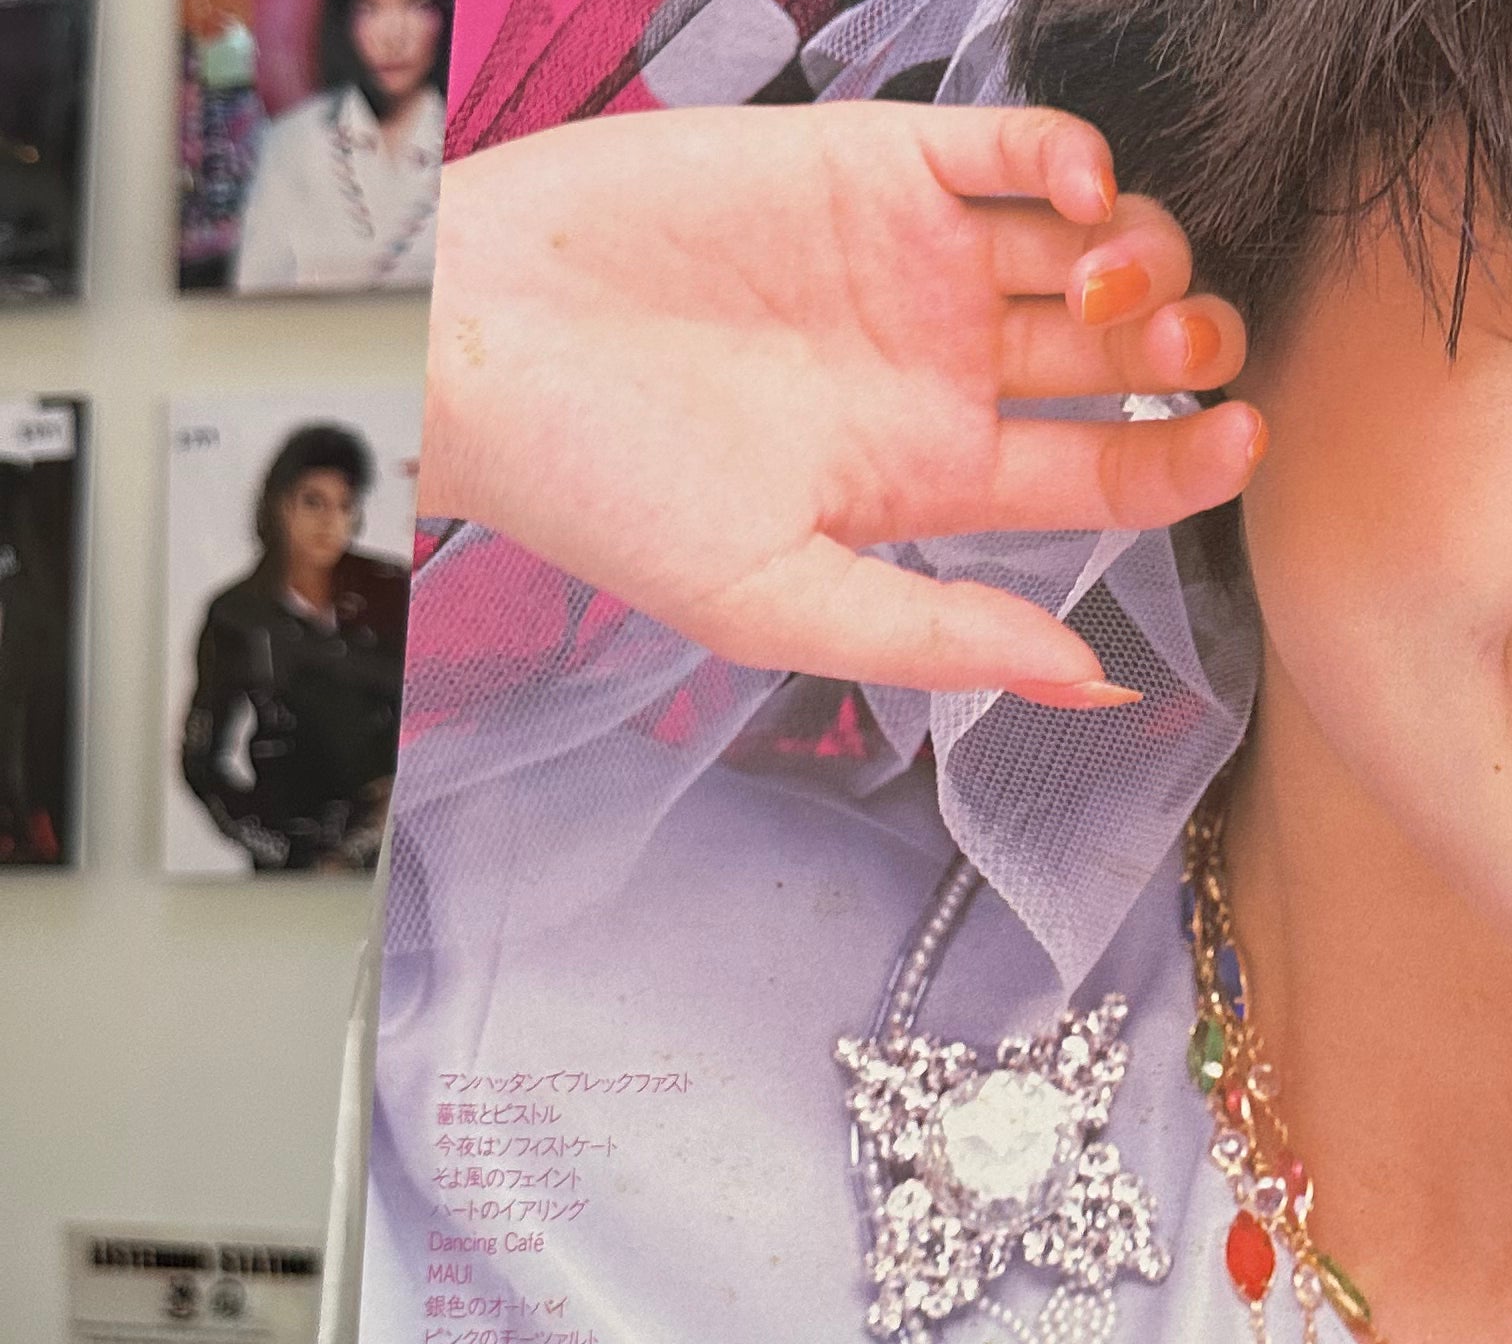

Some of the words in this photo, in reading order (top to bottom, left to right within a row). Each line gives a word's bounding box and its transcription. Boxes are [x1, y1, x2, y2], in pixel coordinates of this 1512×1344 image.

[436, 1103, 562, 1125] 薔薇とピストル
[434, 1133, 618, 1157] 今夜はソフィストケート
[432, 1166, 582, 1190] そよ風のフェイント
[430, 1199, 590, 1222] ハートのイアリング
[429, 1231, 497, 1255] Dancing
[504, 1231, 545, 1253] Café
[427, 1263, 473, 1285] MAUI
[424, 1295, 568, 1319] 銀色のオートバイ
